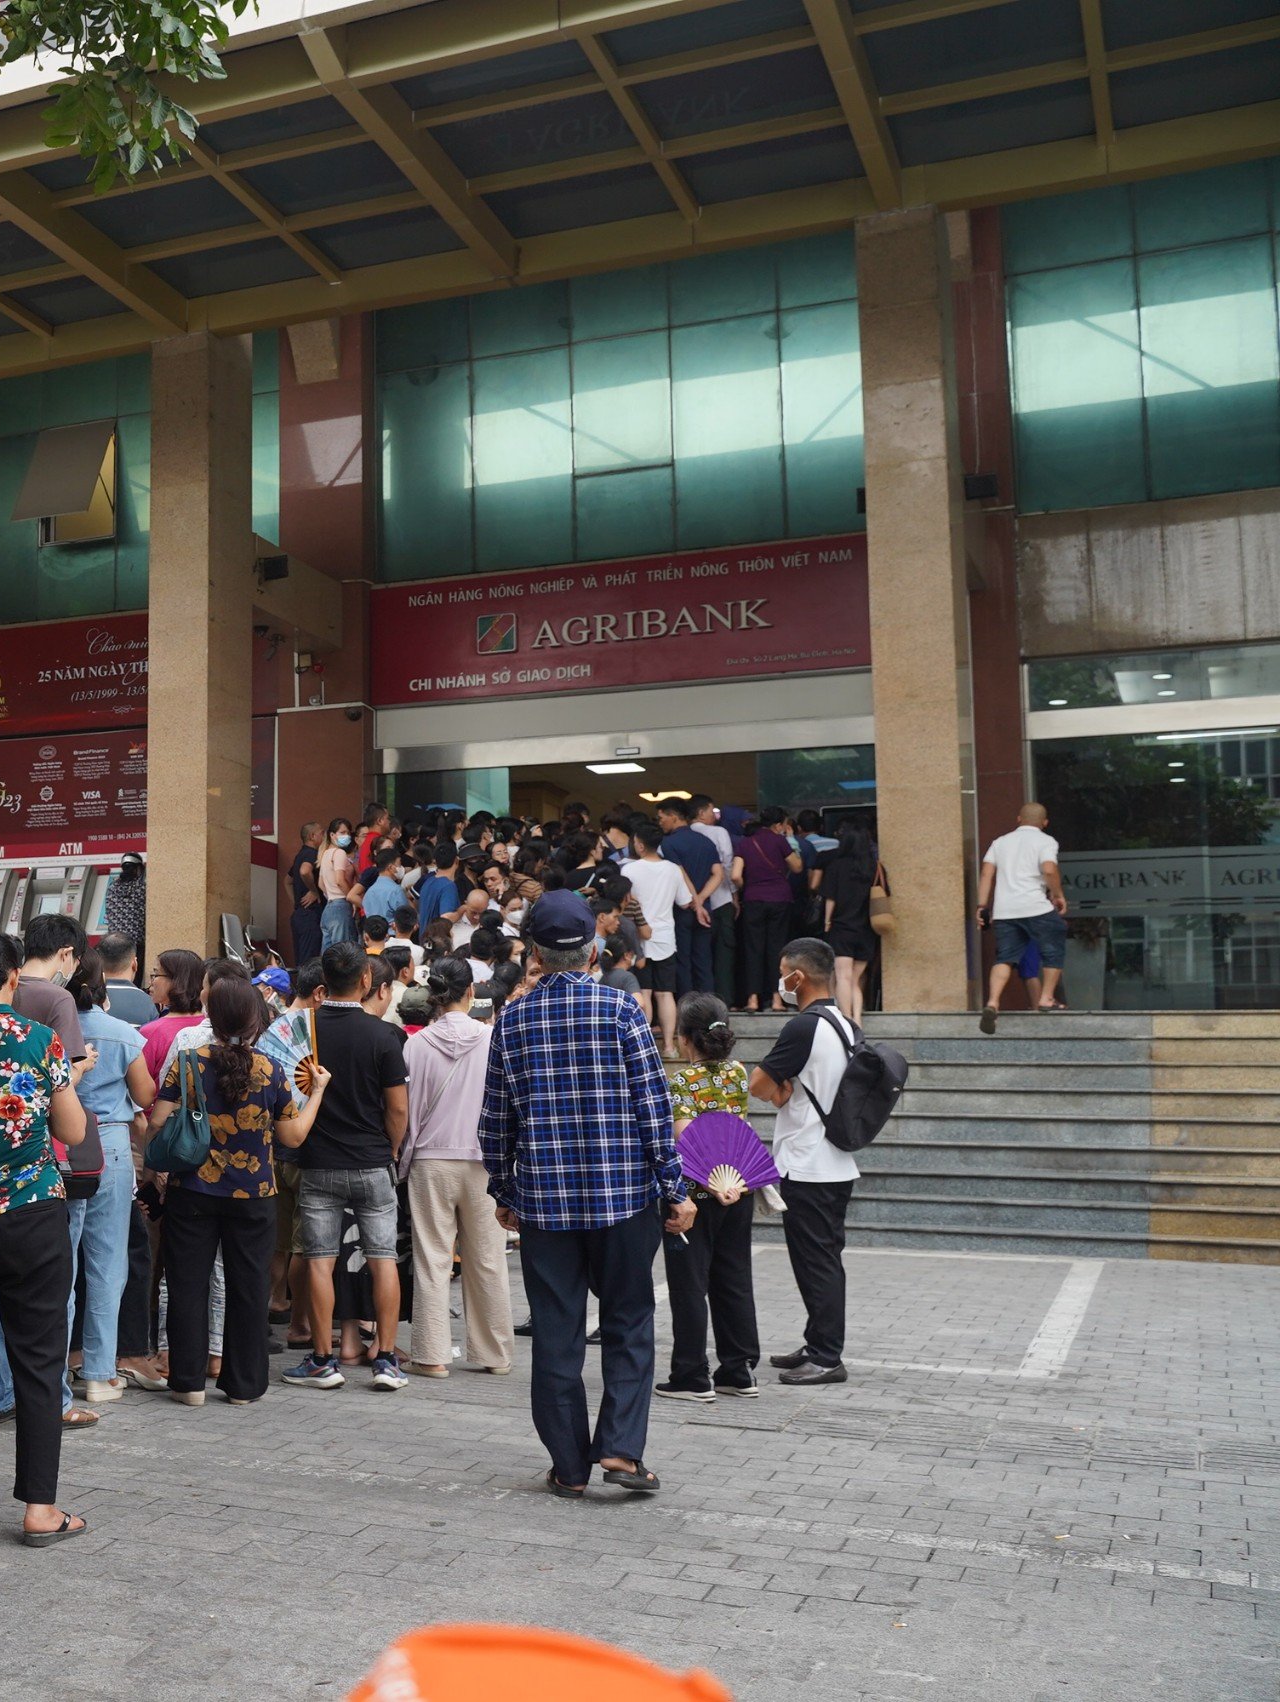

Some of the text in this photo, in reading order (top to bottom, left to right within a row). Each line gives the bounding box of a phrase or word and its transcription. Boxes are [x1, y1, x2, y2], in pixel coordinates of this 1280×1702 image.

[408, 548, 853, 608] NGÂN HÀNG NÔNG NGHIỆP VÀ PHÁT TRIỂN NÔNG THÔN VIỆT NAM
[531, 598, 773, 649] AGRIBANK
[86, 628, 121, 655] Chào
[38, 670, 52, 683] 25
[54, 665, 85, 681] NĂM
[88, 660, 128, 678] NGÀY
[408, 664, 591, 692] CHI NHÁNH SỞ GIAO DỊCH
[70, 687, 118, 702] (13/5/1999
[81, 790, 101, 800] VISA
[59, 842, 83, 856] ATM
[1061, 869, 1187, 889] AGRIBANK
